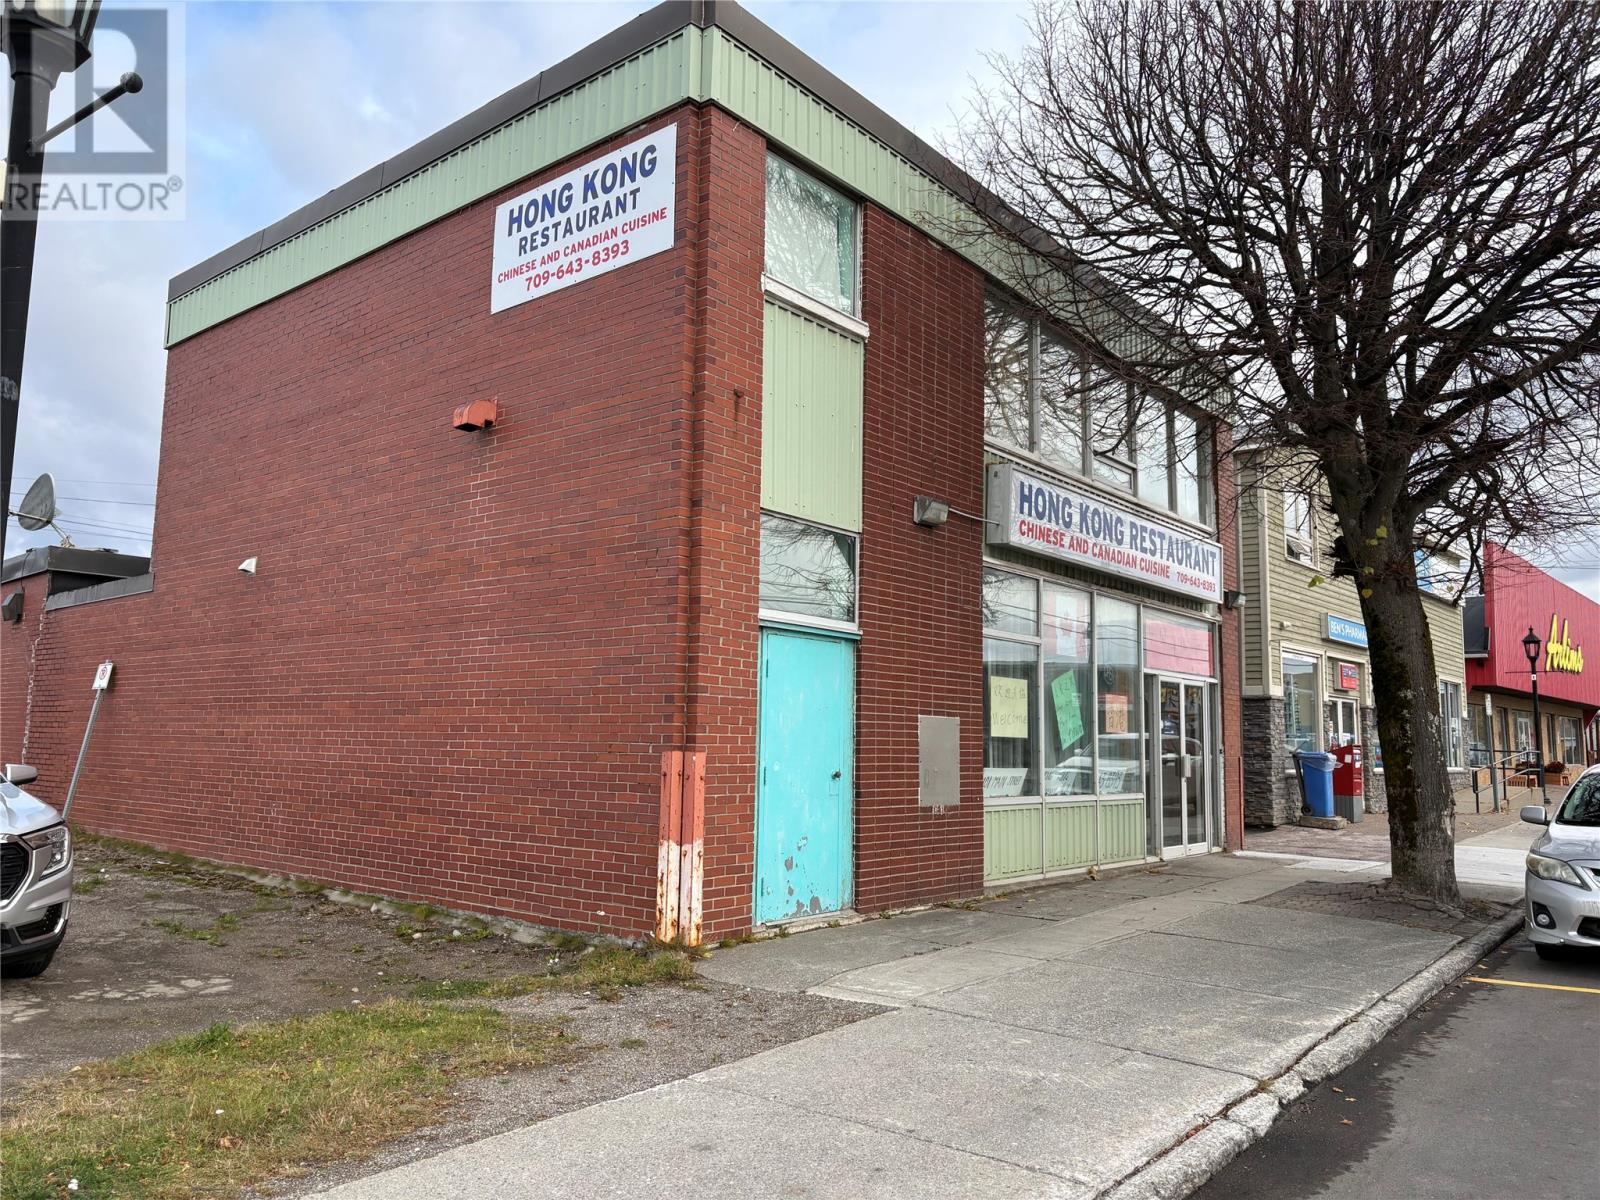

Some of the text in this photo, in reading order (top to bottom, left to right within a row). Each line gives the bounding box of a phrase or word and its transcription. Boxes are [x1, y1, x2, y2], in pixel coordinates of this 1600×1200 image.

[507, 144, 657, 237] HONG KONG
[518, 187, 640, 257] RESTAURANT
[497, 207, 668, 283] CHINESE AND CANADIAN CUISINE
[525, 239, 630, 292] 709-643-8393
[1019, 481, 1217, 577] HONG KONG RESTAURANT
[1019, 519, 1216, 593] CHINESE AND CANADIAN CUISINE 709-643-8393
[1330, 621, 1368, 641] BEN'S PHARMA
